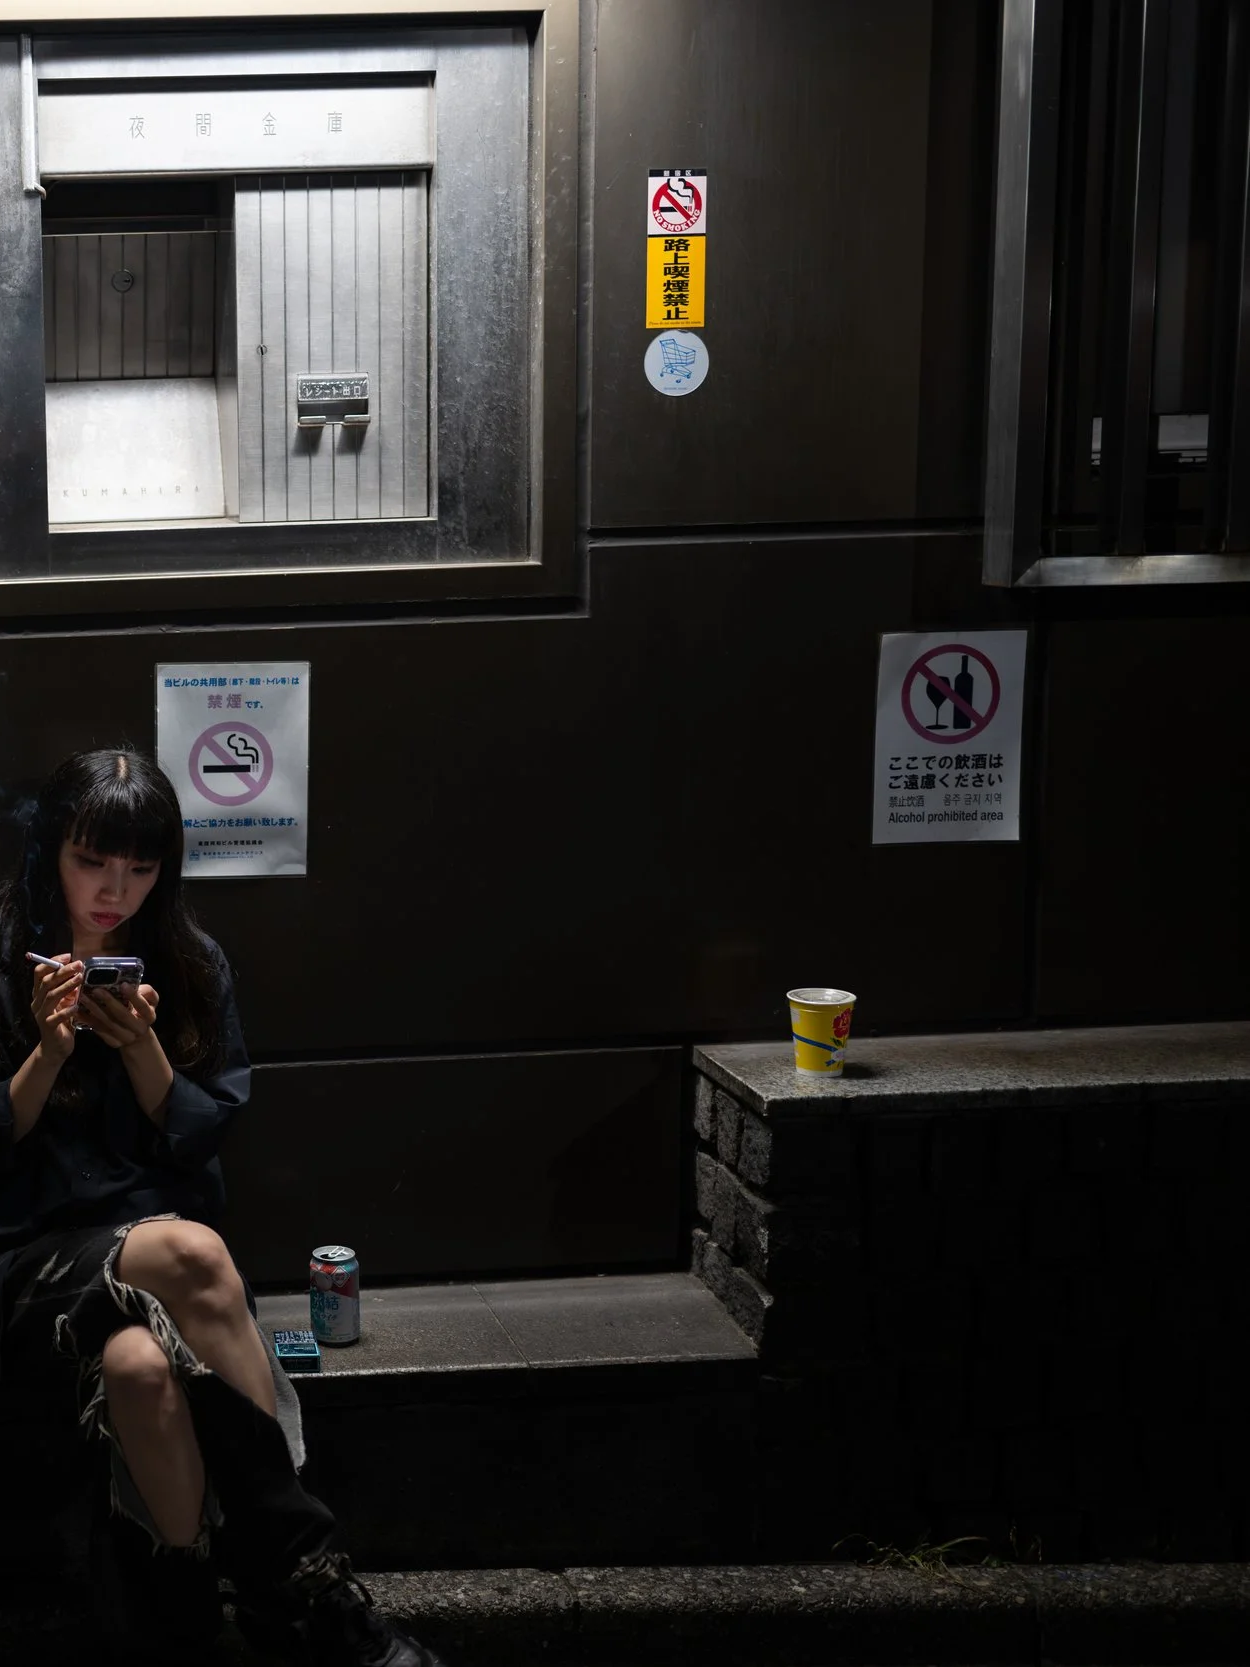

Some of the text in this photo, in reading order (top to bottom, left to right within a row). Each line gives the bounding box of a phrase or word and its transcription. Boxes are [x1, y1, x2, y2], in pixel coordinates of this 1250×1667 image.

[128, 111, 343, 139] 夜間金庫
[653, 209, 701, 232] NO SMOKING
[662, 238, 691, 321] 路上喫煙禁止
[63, 485, 200, 498] KUMAHIRA
[889, 753, 1004, 771] ここでの飲酒は
[888, 773, 1003, 790] ご遠慮ください
[888, 795, 925, 808] 禁止饮酒
[964, 793, 982, 806] 금지
[984, 792, 1002, 805] 지역
[181, 817, 299, 828] 解とご協力をお願い致します。
[888, 810, 1004, 825] Alcohol prohibited area
